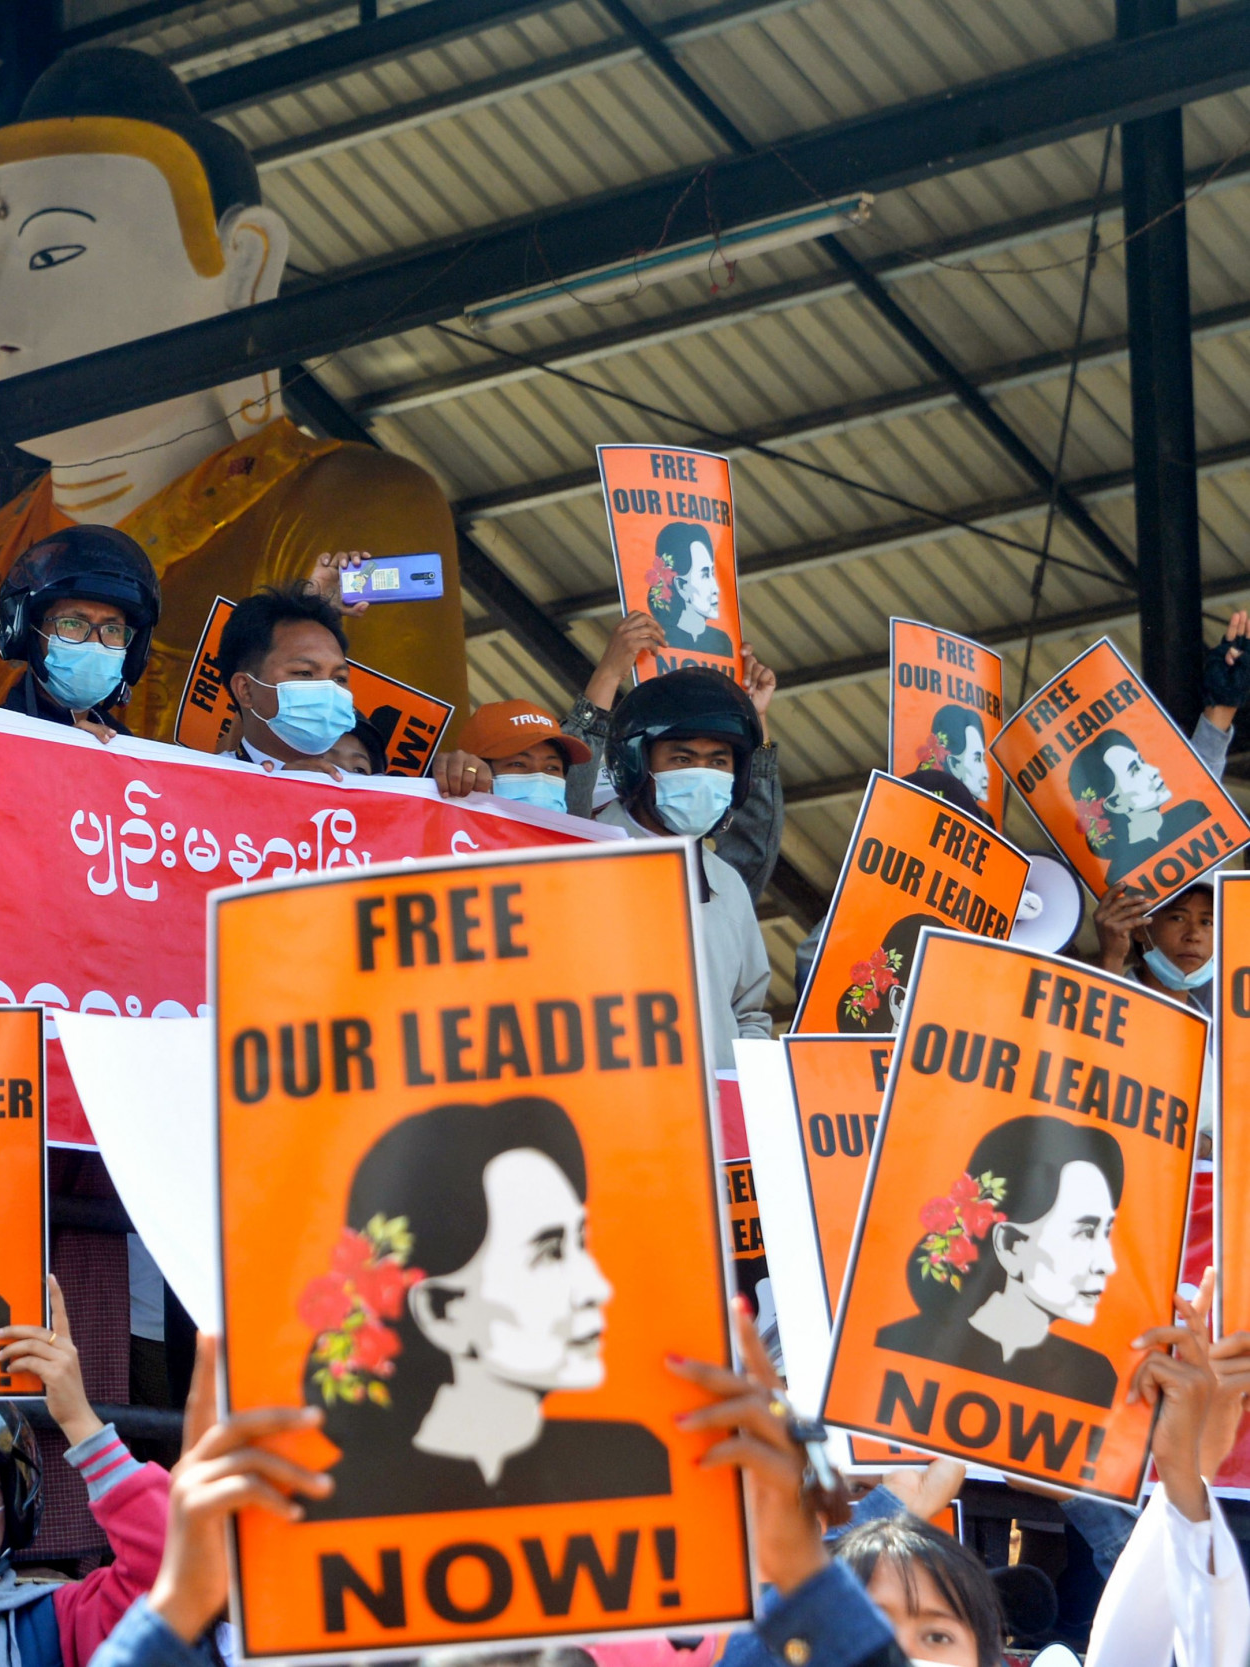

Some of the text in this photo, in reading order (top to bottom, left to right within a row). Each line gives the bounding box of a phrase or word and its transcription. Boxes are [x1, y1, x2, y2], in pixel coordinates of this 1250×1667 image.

[612, 488, 732, 528] OUR LEADER
[650, 452, 699, 485] FREE
[897, 662, 1001, 721] OUR LEADER
[936, 635, 976, 673] FREE
[510, 713, 553, 728] TRUST
[1016, 678, 1142, 794] OUR LEADER
[1024, 679, 1081, 735] FREE
[929, 812, 991, 876] FREE
[356, 884, 529, 972] FREE
[857, 837, 1009, 940] OUR LEADER
[1022, 968, 1130, 1047] FREE
[232, 994, 684, 1105] OUR LEADER
[911, 1023, 1021, 1093] OUR
[1031, 1049, 1190, 1150] LEADER
[875, 1370, 1107, 1483] NOW!
[318, 1527, 682, 1635] NOW!
